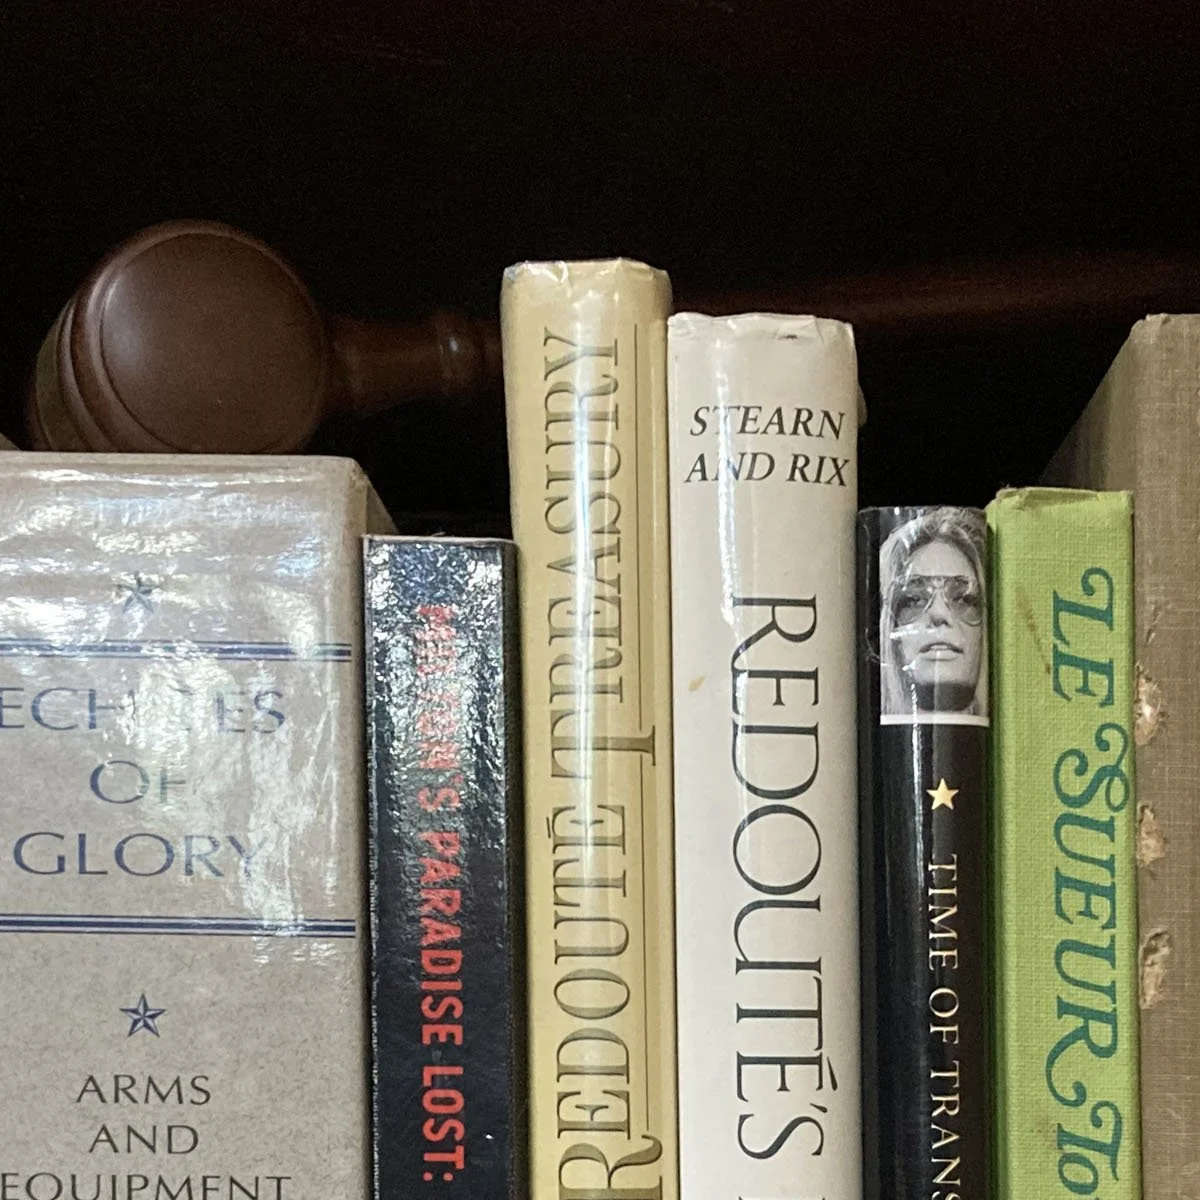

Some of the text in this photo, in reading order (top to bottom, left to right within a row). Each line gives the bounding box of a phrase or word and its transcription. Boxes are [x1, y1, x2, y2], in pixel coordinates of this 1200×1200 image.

[690, 406, 846, 440] STEARN
[684, 452, 851, 487] AND RIX
[543, 326, 657, 780] TREASURY
[1052, 566, 1115, 706] LE
[89, 760, 187, 804] OF
[13, 832, 268, 877] GLORY
[418, 831, 464, 1045] PARADISE
[927, 853, 959, 971] TIME
[1045, 722, 1130, 1108] SUEUR
[928, 987, 960, 1046] OF
[76, 1074, 212, 1106] ARMS
[88, 1124, 200, 1155] AND
[421, 1065, 466, 1182] LOST:
